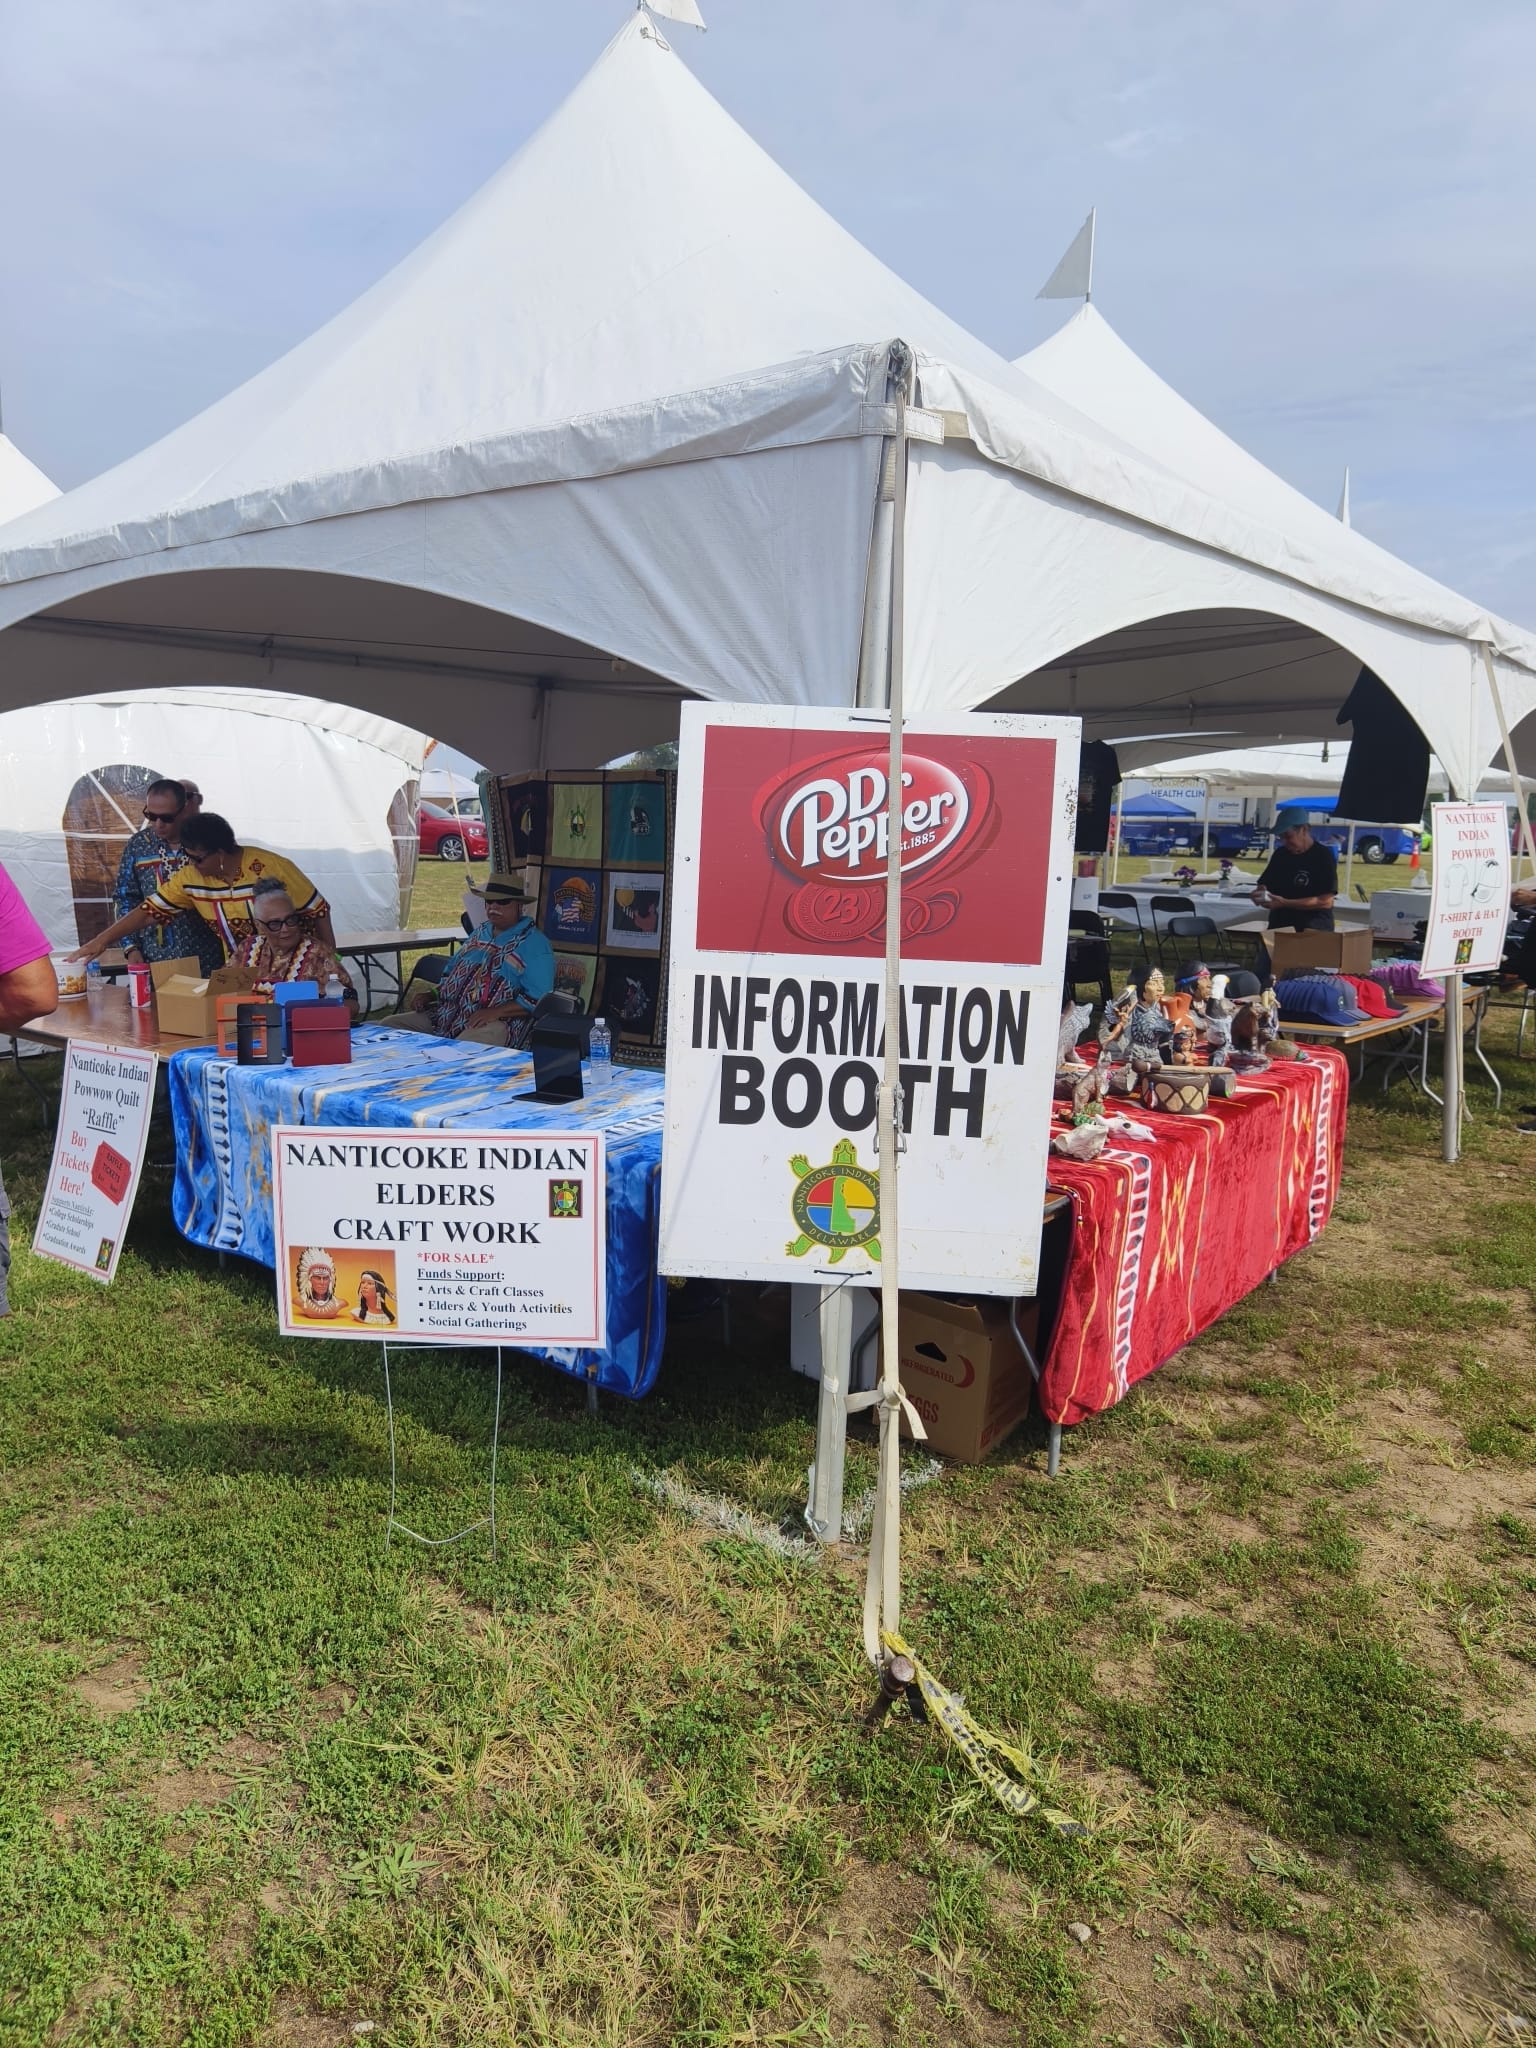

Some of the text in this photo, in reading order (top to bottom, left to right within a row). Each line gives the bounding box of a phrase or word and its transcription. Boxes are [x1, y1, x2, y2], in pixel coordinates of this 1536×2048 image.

[1151, 789, 1183, 798] HEALTH
[780, 778, 954, 868] Pepper
[1445, 812, 1497, 824] NANTICOKE
[896, 831, 936, 852] st.1885
[1458, 830, 1489, 841] INDIAN
[1451, 847, 1496, 861] POWWOW
[822, 889, 860, 924] 23
[1439, 908, 1500, 924] T-SHIRT & HAT
[1452, 926, 1483, 939] BOOTH
[692, 974, 1031, 1065] INFORMATION
[70, 1053, 149, 1083] Nanticoke Indian
[74, 1079, 140, 1108] Powwow Quilt
[719, 1055, 987, 1138] BOOTH
[71, 1130, 87, 1151] Buy
[60, 1151, 89, 1173] Tickets
[286, 1144, 588, 1171] NANTICOKE INDIAN
[60, 1176, 85, 1196] Here!
[376, 1183, 495, 1207] ELDERS
[796, 1168, 837, 1213] NANTICOKE
[333, 1218, 542, 1244] CRAFT WORK
[809, 1228, 871, 1245] DELAWARE
[417, 1268, 505, 1282] Funds Support:
[428, 1285, 544, 1297] Arts & Craft Classes
[428, 1301, 573, 1314] Elders & Youth Activities
[428, 1317, 527, 1331] Social Gatherings
